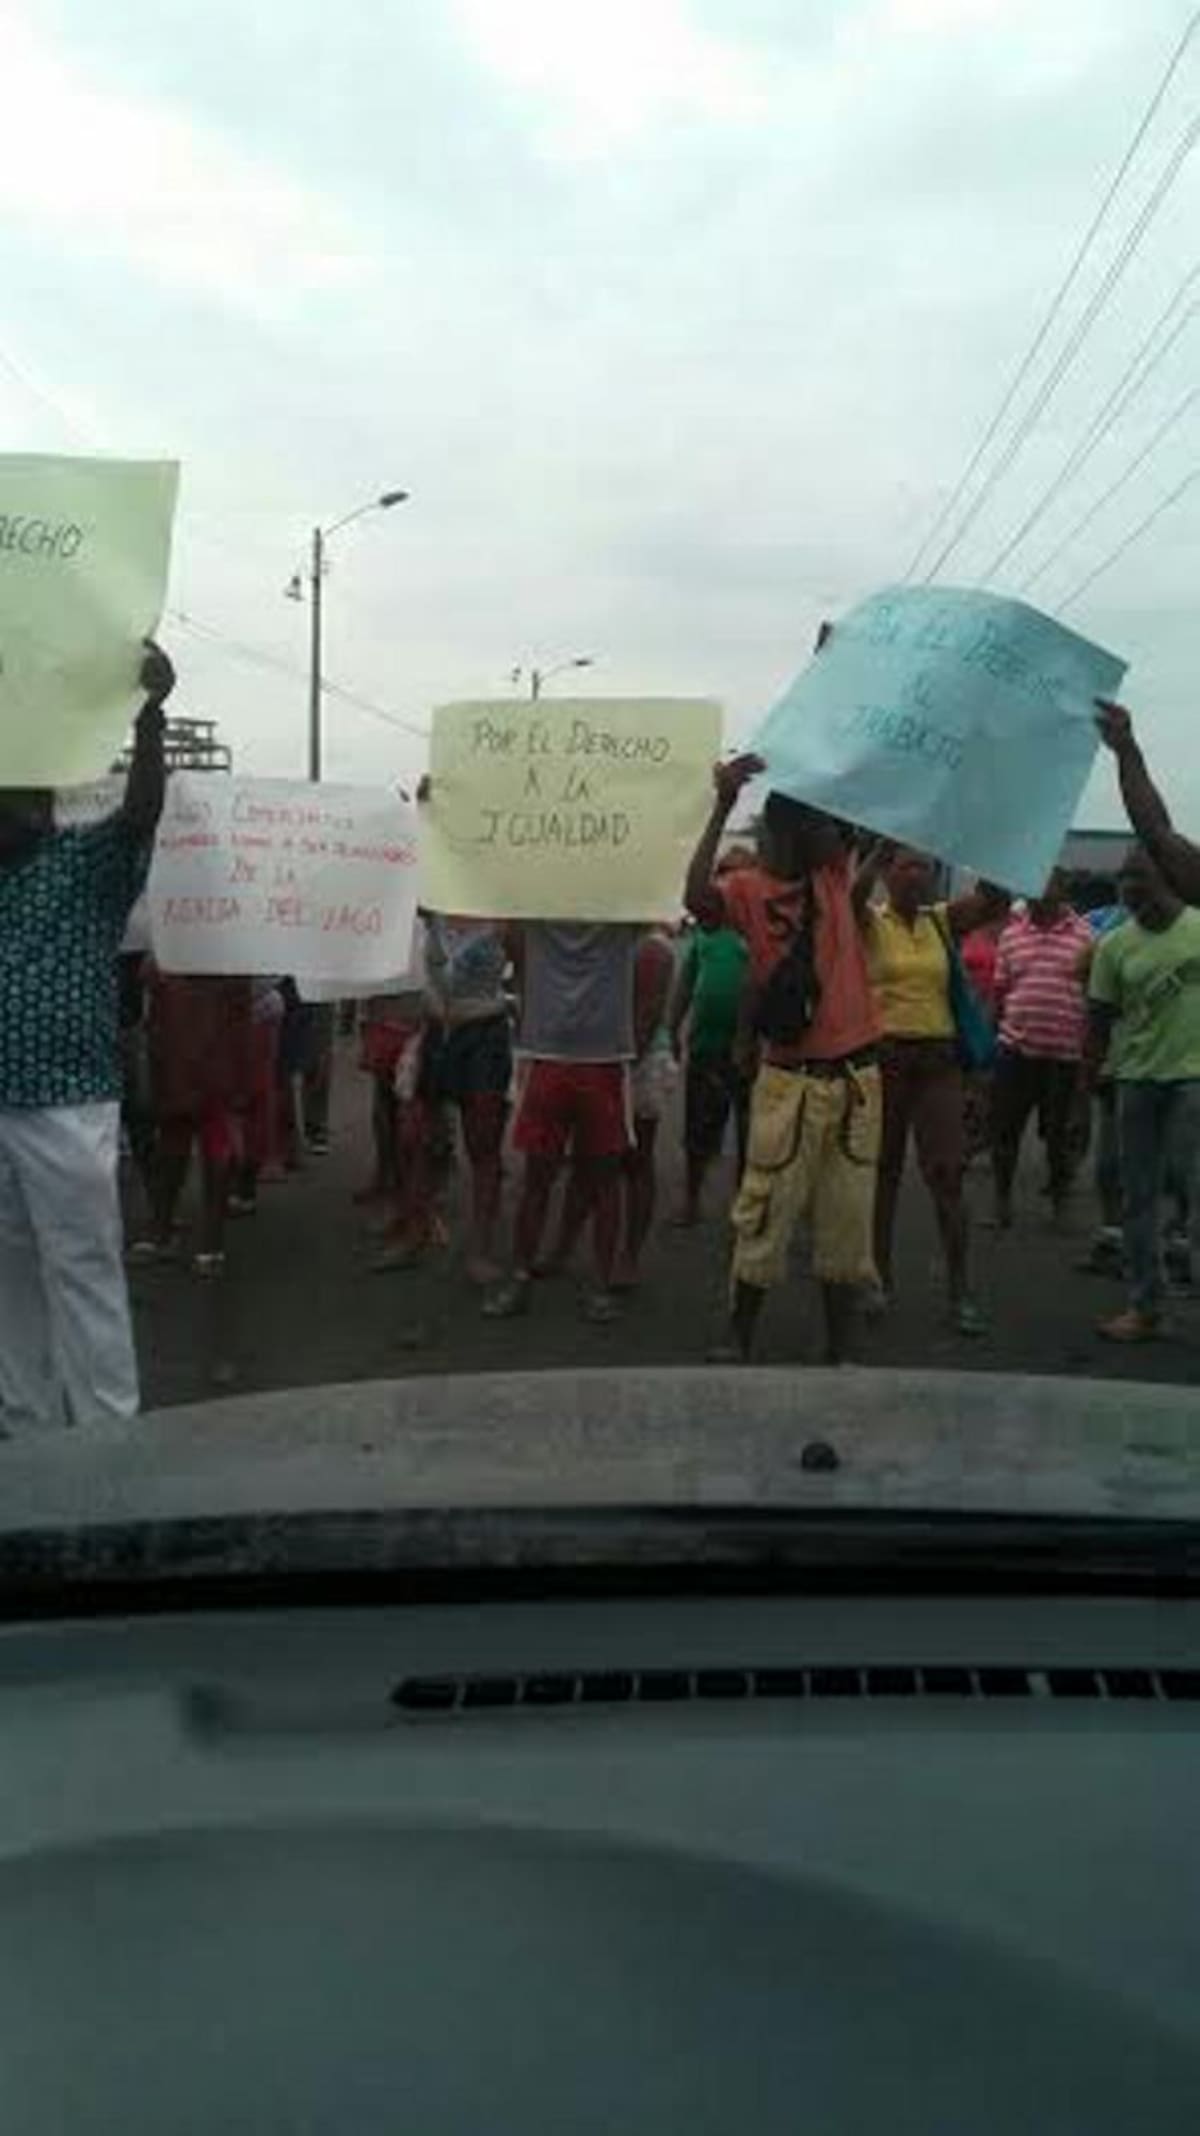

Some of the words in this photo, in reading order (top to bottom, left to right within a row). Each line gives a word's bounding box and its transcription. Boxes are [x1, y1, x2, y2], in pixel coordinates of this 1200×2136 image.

[475, 716, 518, 753] POR
[526, 720, 552, 754] EL
[567, 719, 671, 763] DERECHO
[523, 766, 542, 799] A
[561, 766, 590, 802] LA
[479, 808, 631, 847] IGUALDAD
